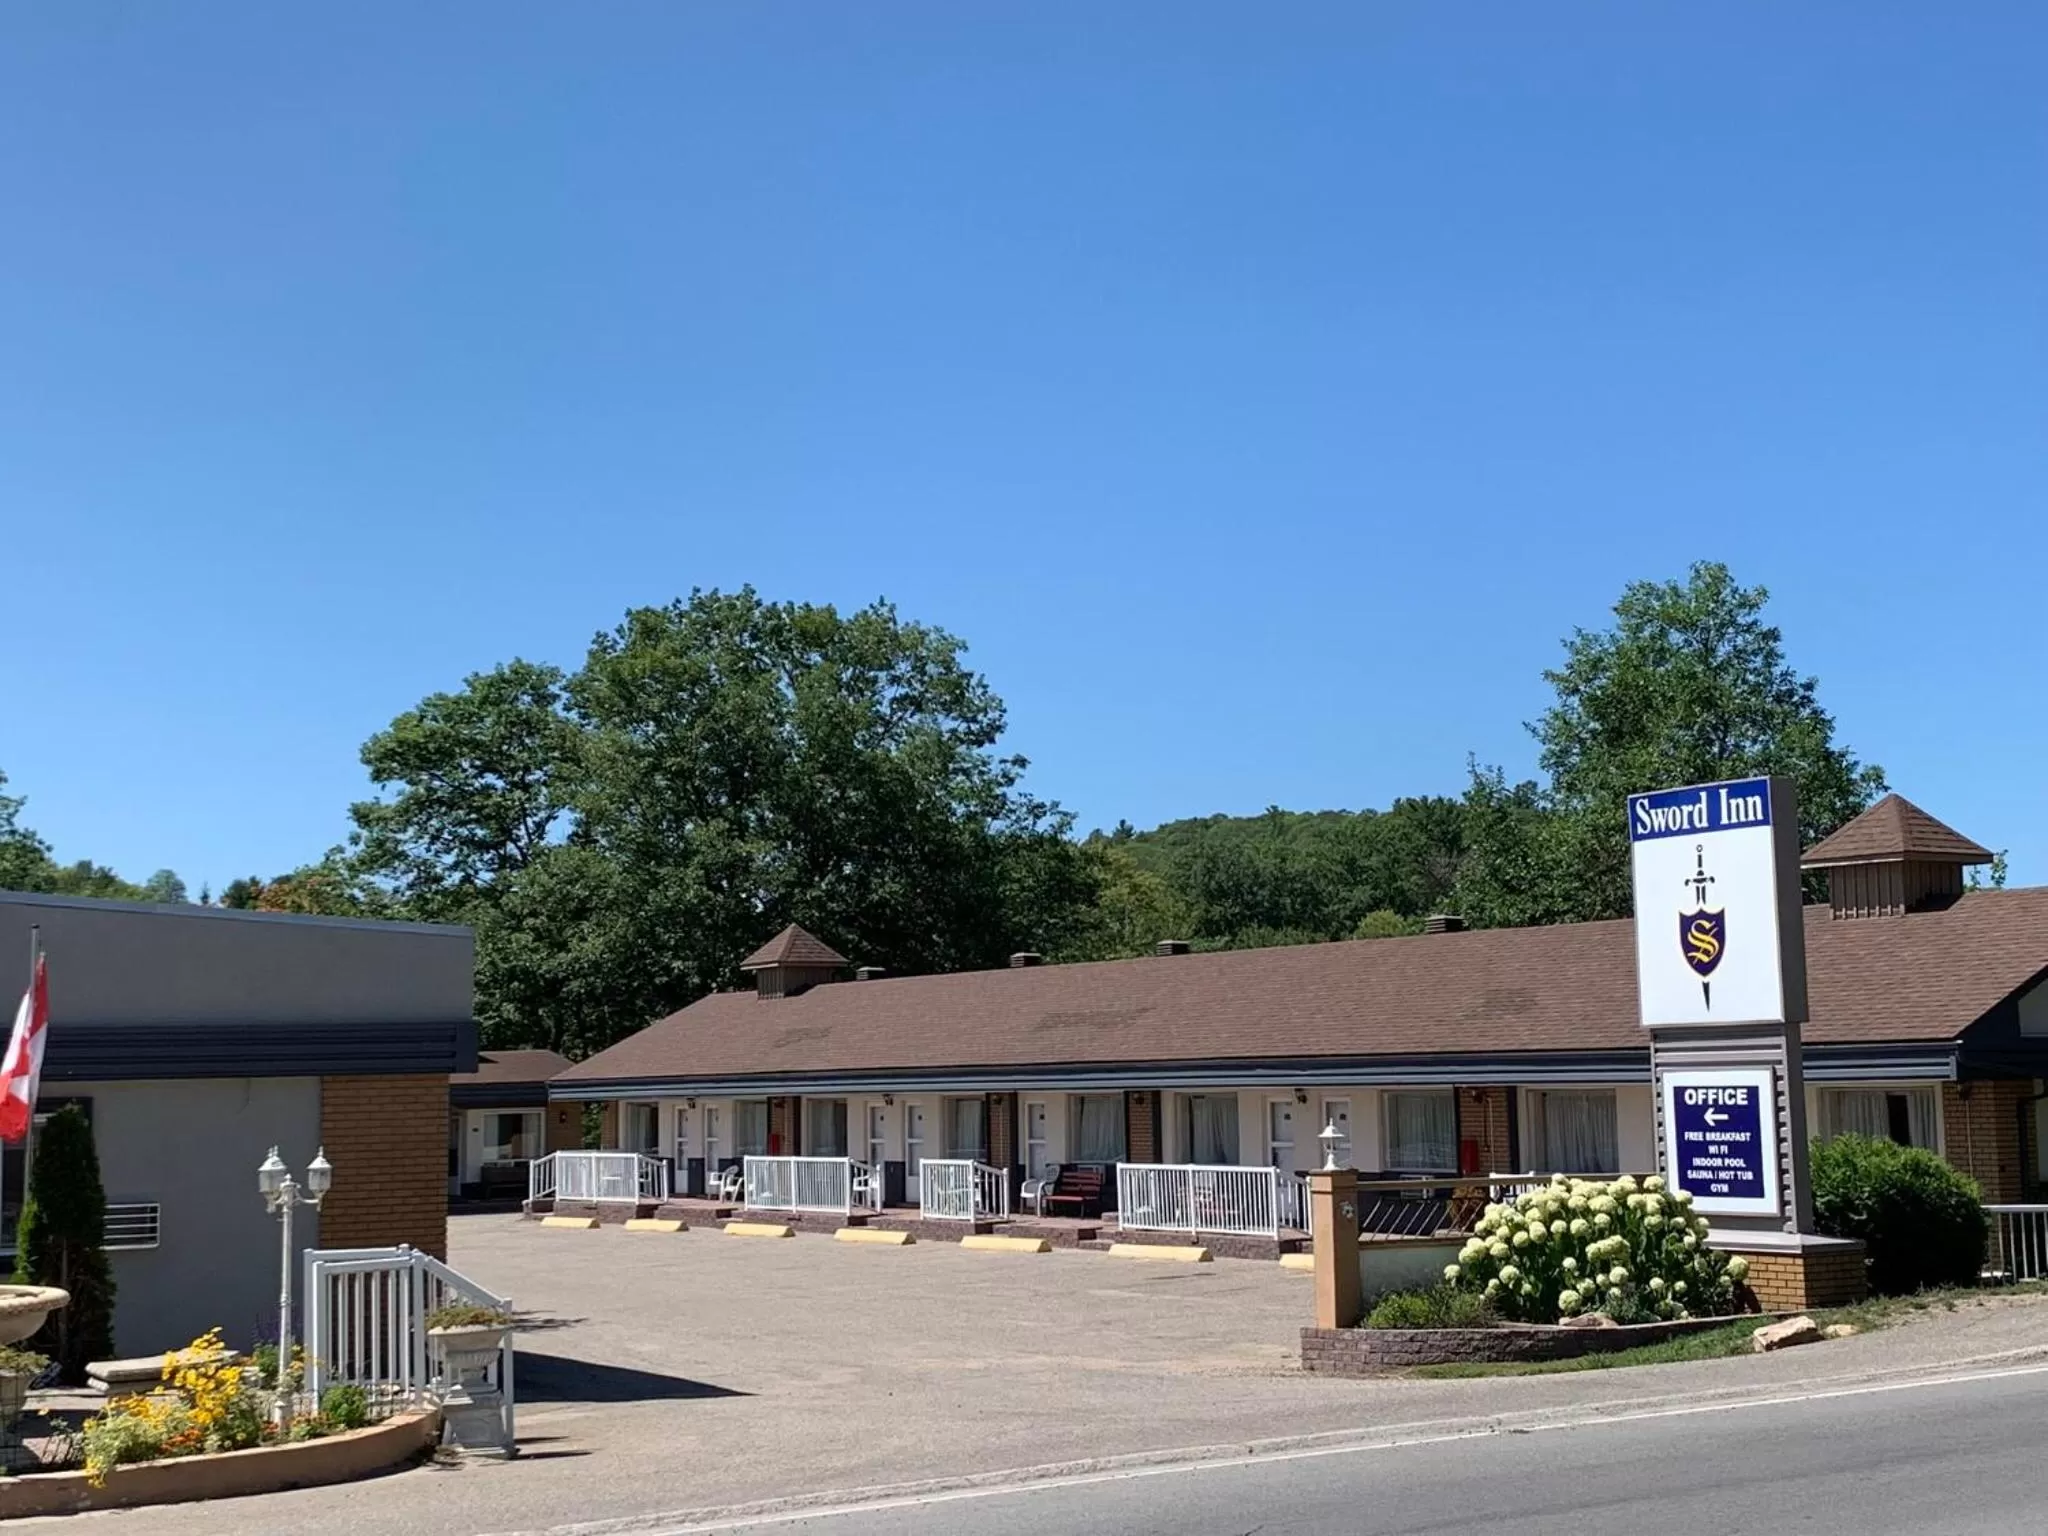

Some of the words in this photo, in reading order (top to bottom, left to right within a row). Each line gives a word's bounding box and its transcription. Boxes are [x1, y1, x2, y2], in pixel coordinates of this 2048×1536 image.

[1635, 791, 1709, 835] Sword
[1719, 788, 1764, 825] Inn
[1687, 919, 1719, 964] S
[1684, 1088, 1748, 1105] OFFICE
[1684, 1131, 1704, 1141] FREE
[1705, 1131, 1751, 1142] BREAKFAST
[1692, 1157, 1722, 1167] INDOOR
[1724, 1158, 1746, 1168] POOL
[1687, 1169, 1713, 1179] SAUNA
[1719, 1170, 1734, 1180] HOT
[1737, 1171, 1754, 1180] TUB
[1710, 1183, 1729, 1192] GYM
